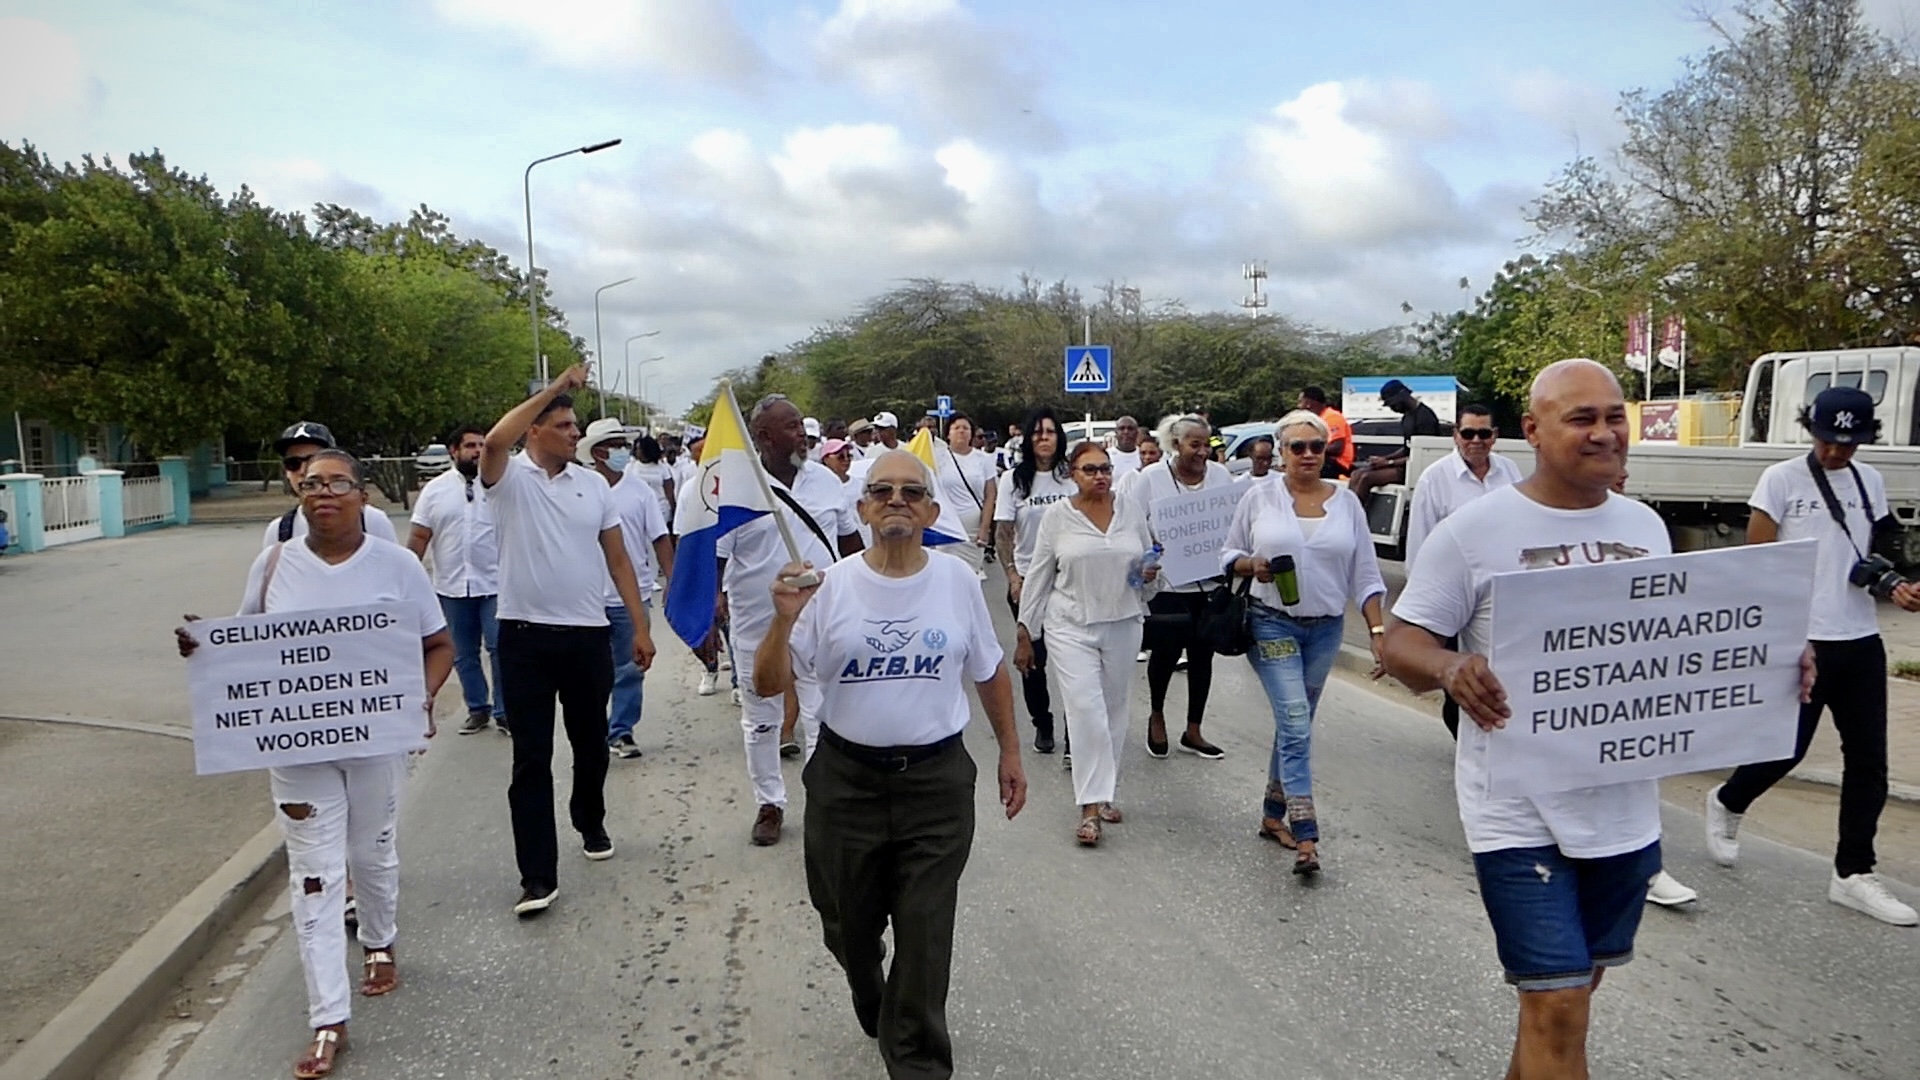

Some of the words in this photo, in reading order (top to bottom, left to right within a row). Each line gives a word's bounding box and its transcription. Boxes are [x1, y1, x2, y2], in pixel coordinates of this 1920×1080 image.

[1158, 500, 1206, 521] HUNTU
[1210, 496, 1227, 510] PA
[1231, 491, 1244, 505] U
[1159, 518, 1220, 542] BONEIRU
[1183, 534, 1228, 557] SOSIA
[1629, 572, 1688, 600] EEN
[210, 612, 397, 646] GELIJKWAARDIG-
[1543, 606, 1763, 653] MENSWAARDIG
[280, 646, 331, 666] HEID
[840, 655, 944, 677] A.F.B.W.
[1532, 657, 1669, 694] BESTAAN
[1676, 653, 1703, 676] IS
[1711, 644, 1769, 672] EEN
[227, 681, 271, 701] MET
[279, 673, 353, 695] DADEN
[360, 669, 388, 686] EN
[216, 709, 263, 729] NIET
[270, 699, 354, 724] ALLEEN
[361, 694, 404, 714] MET
[1532, 684, 1764, 734] FUNDAMENTEEL
[256, 725, 370, 752] WOORDEN
[1599, 730, 1696, 764] RECHT
